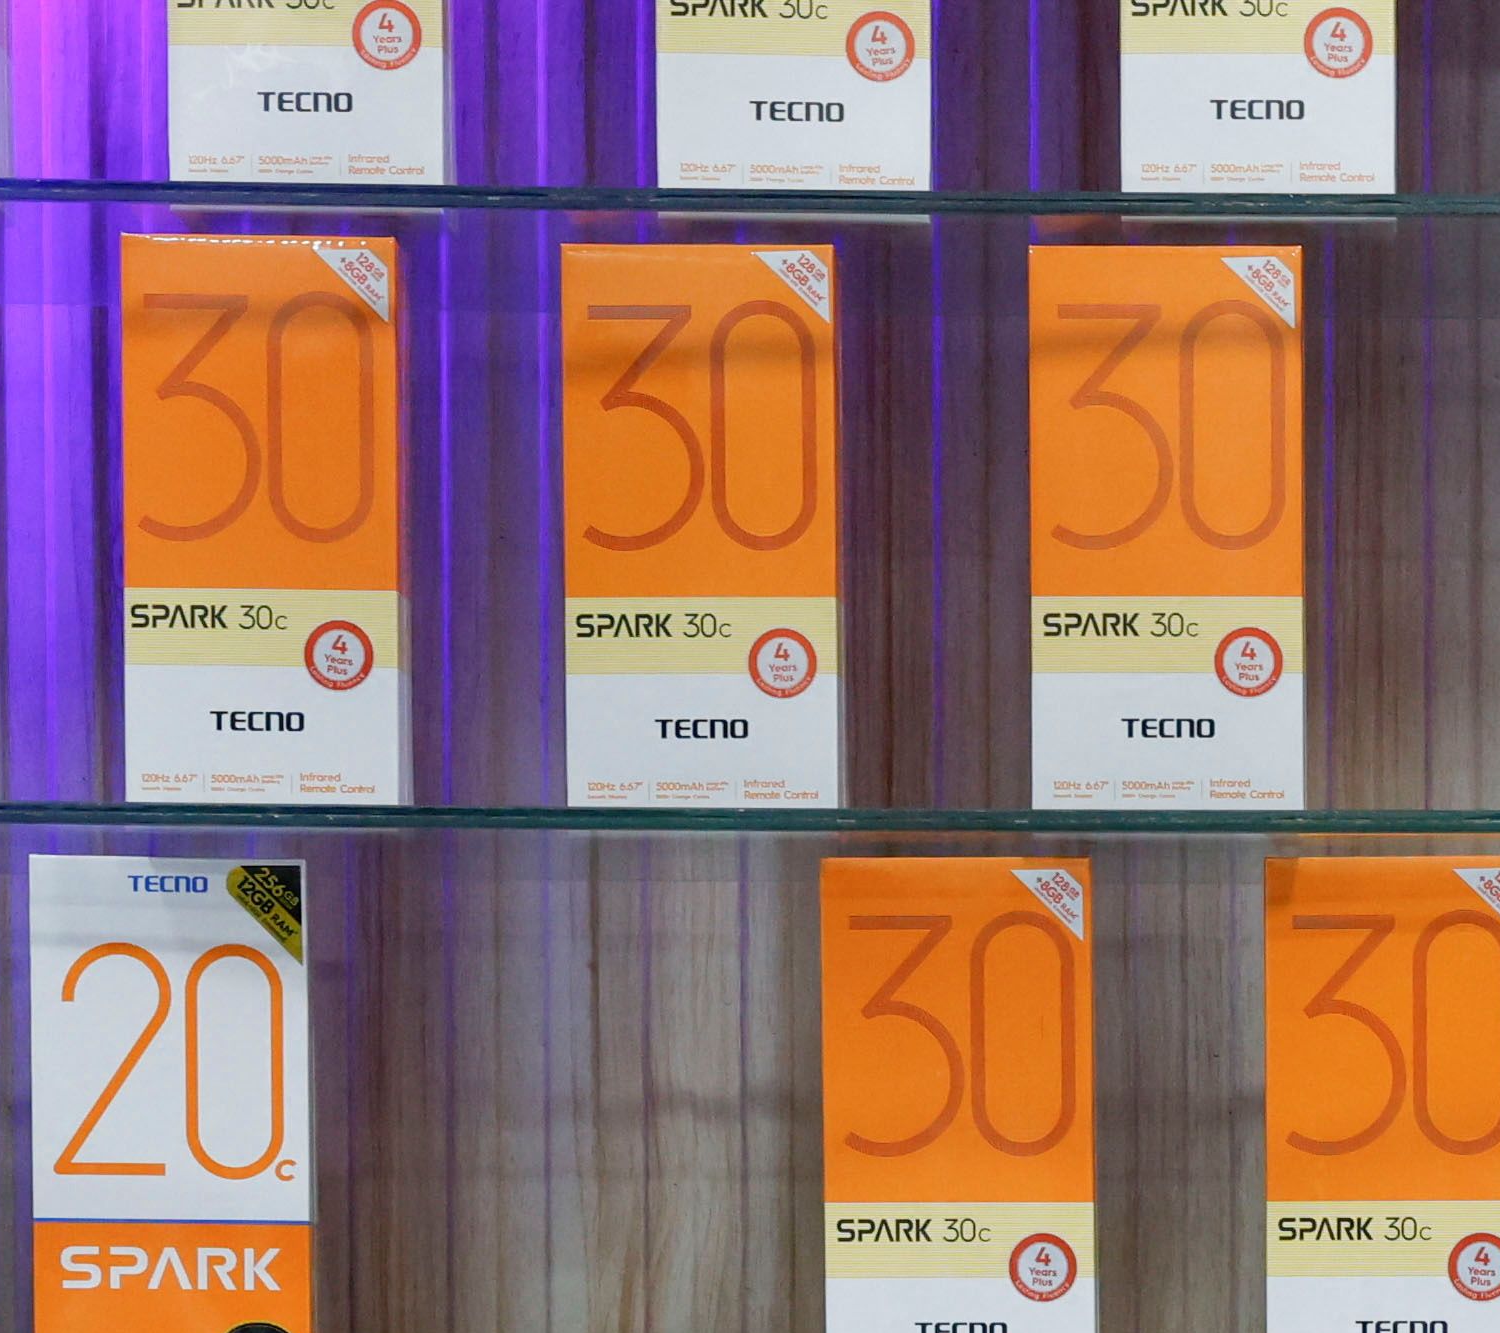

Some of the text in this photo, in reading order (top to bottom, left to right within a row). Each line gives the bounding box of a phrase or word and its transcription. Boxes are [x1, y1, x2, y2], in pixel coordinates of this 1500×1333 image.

[130, 604, 228, 628] SPARK
[210, 710, 304, 732] TECNO
[1278, 1216, 1374, 1240] SPARK
[60, 1246, 280, 1292] SPARK
